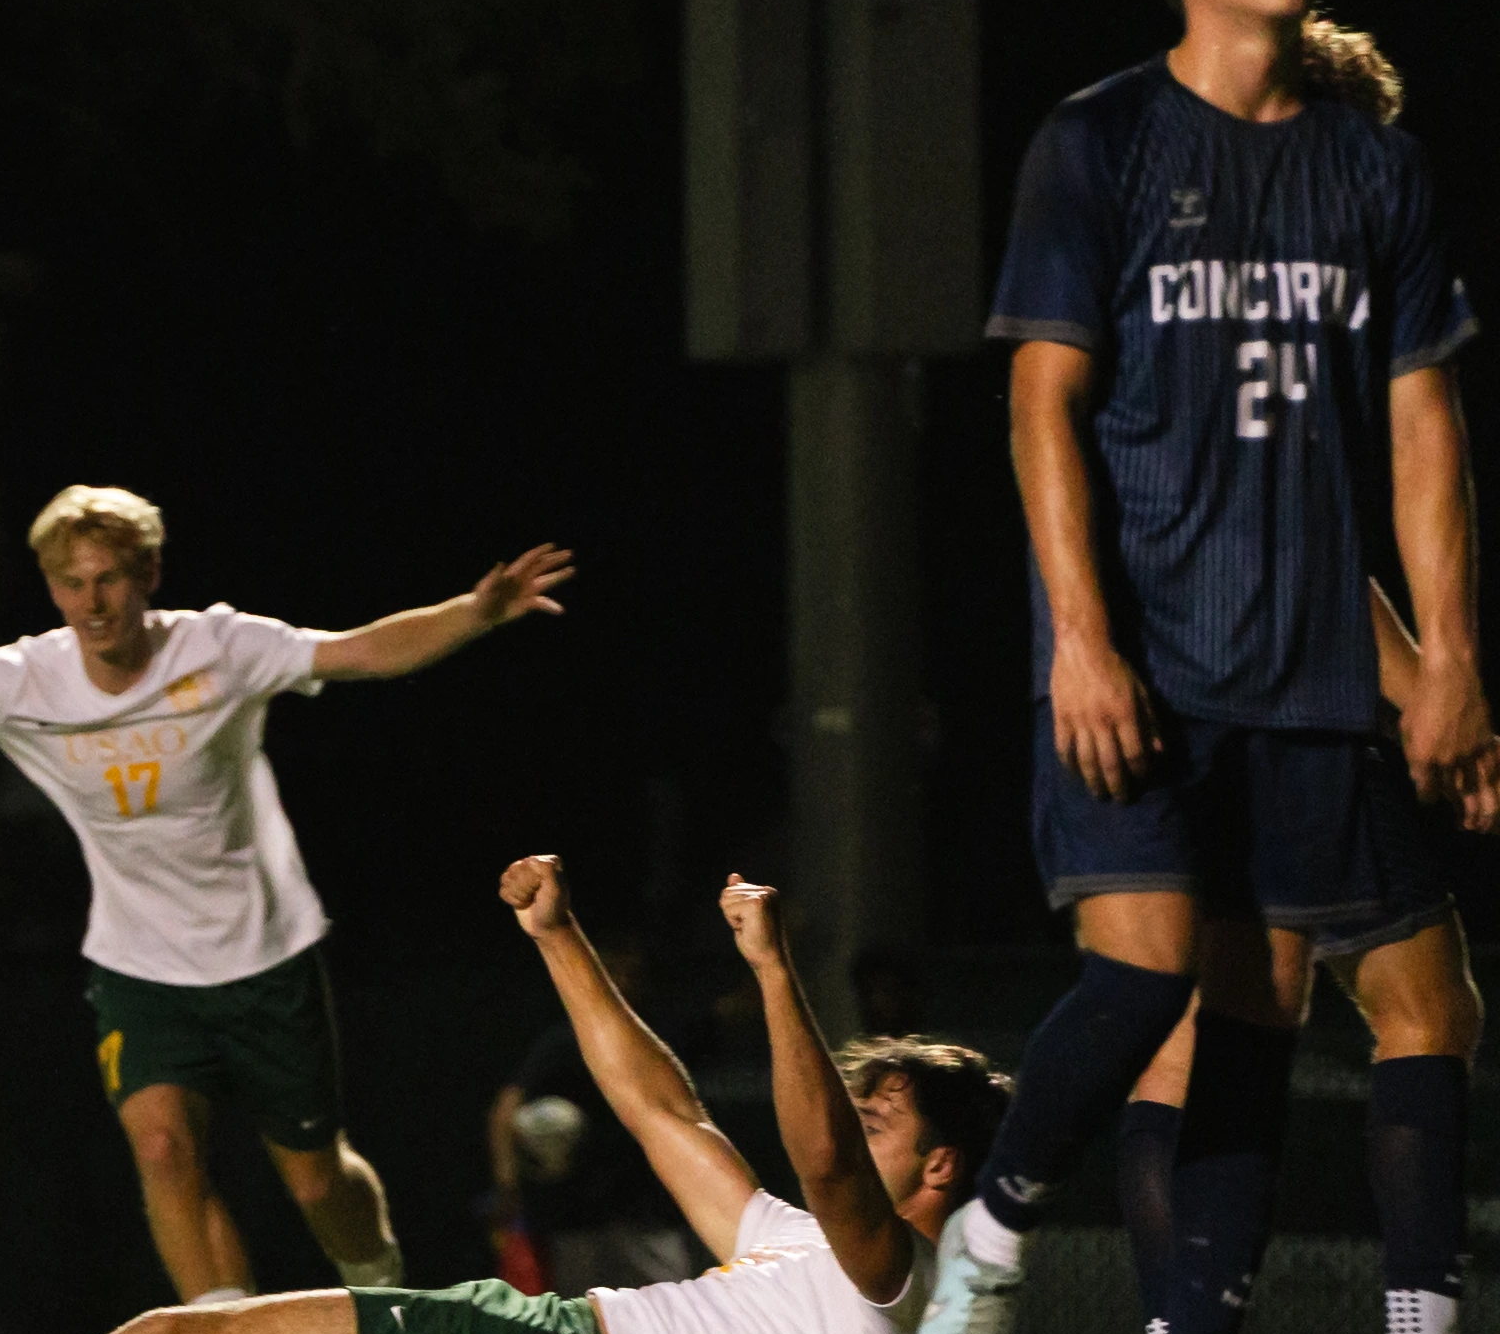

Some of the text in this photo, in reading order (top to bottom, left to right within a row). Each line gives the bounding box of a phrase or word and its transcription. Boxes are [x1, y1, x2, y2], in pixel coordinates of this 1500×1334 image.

[1148, 259, 1371, 330] CONCORD
[1235, 341, 1320, 439] 24
[104, 761, 161, 817] 17
